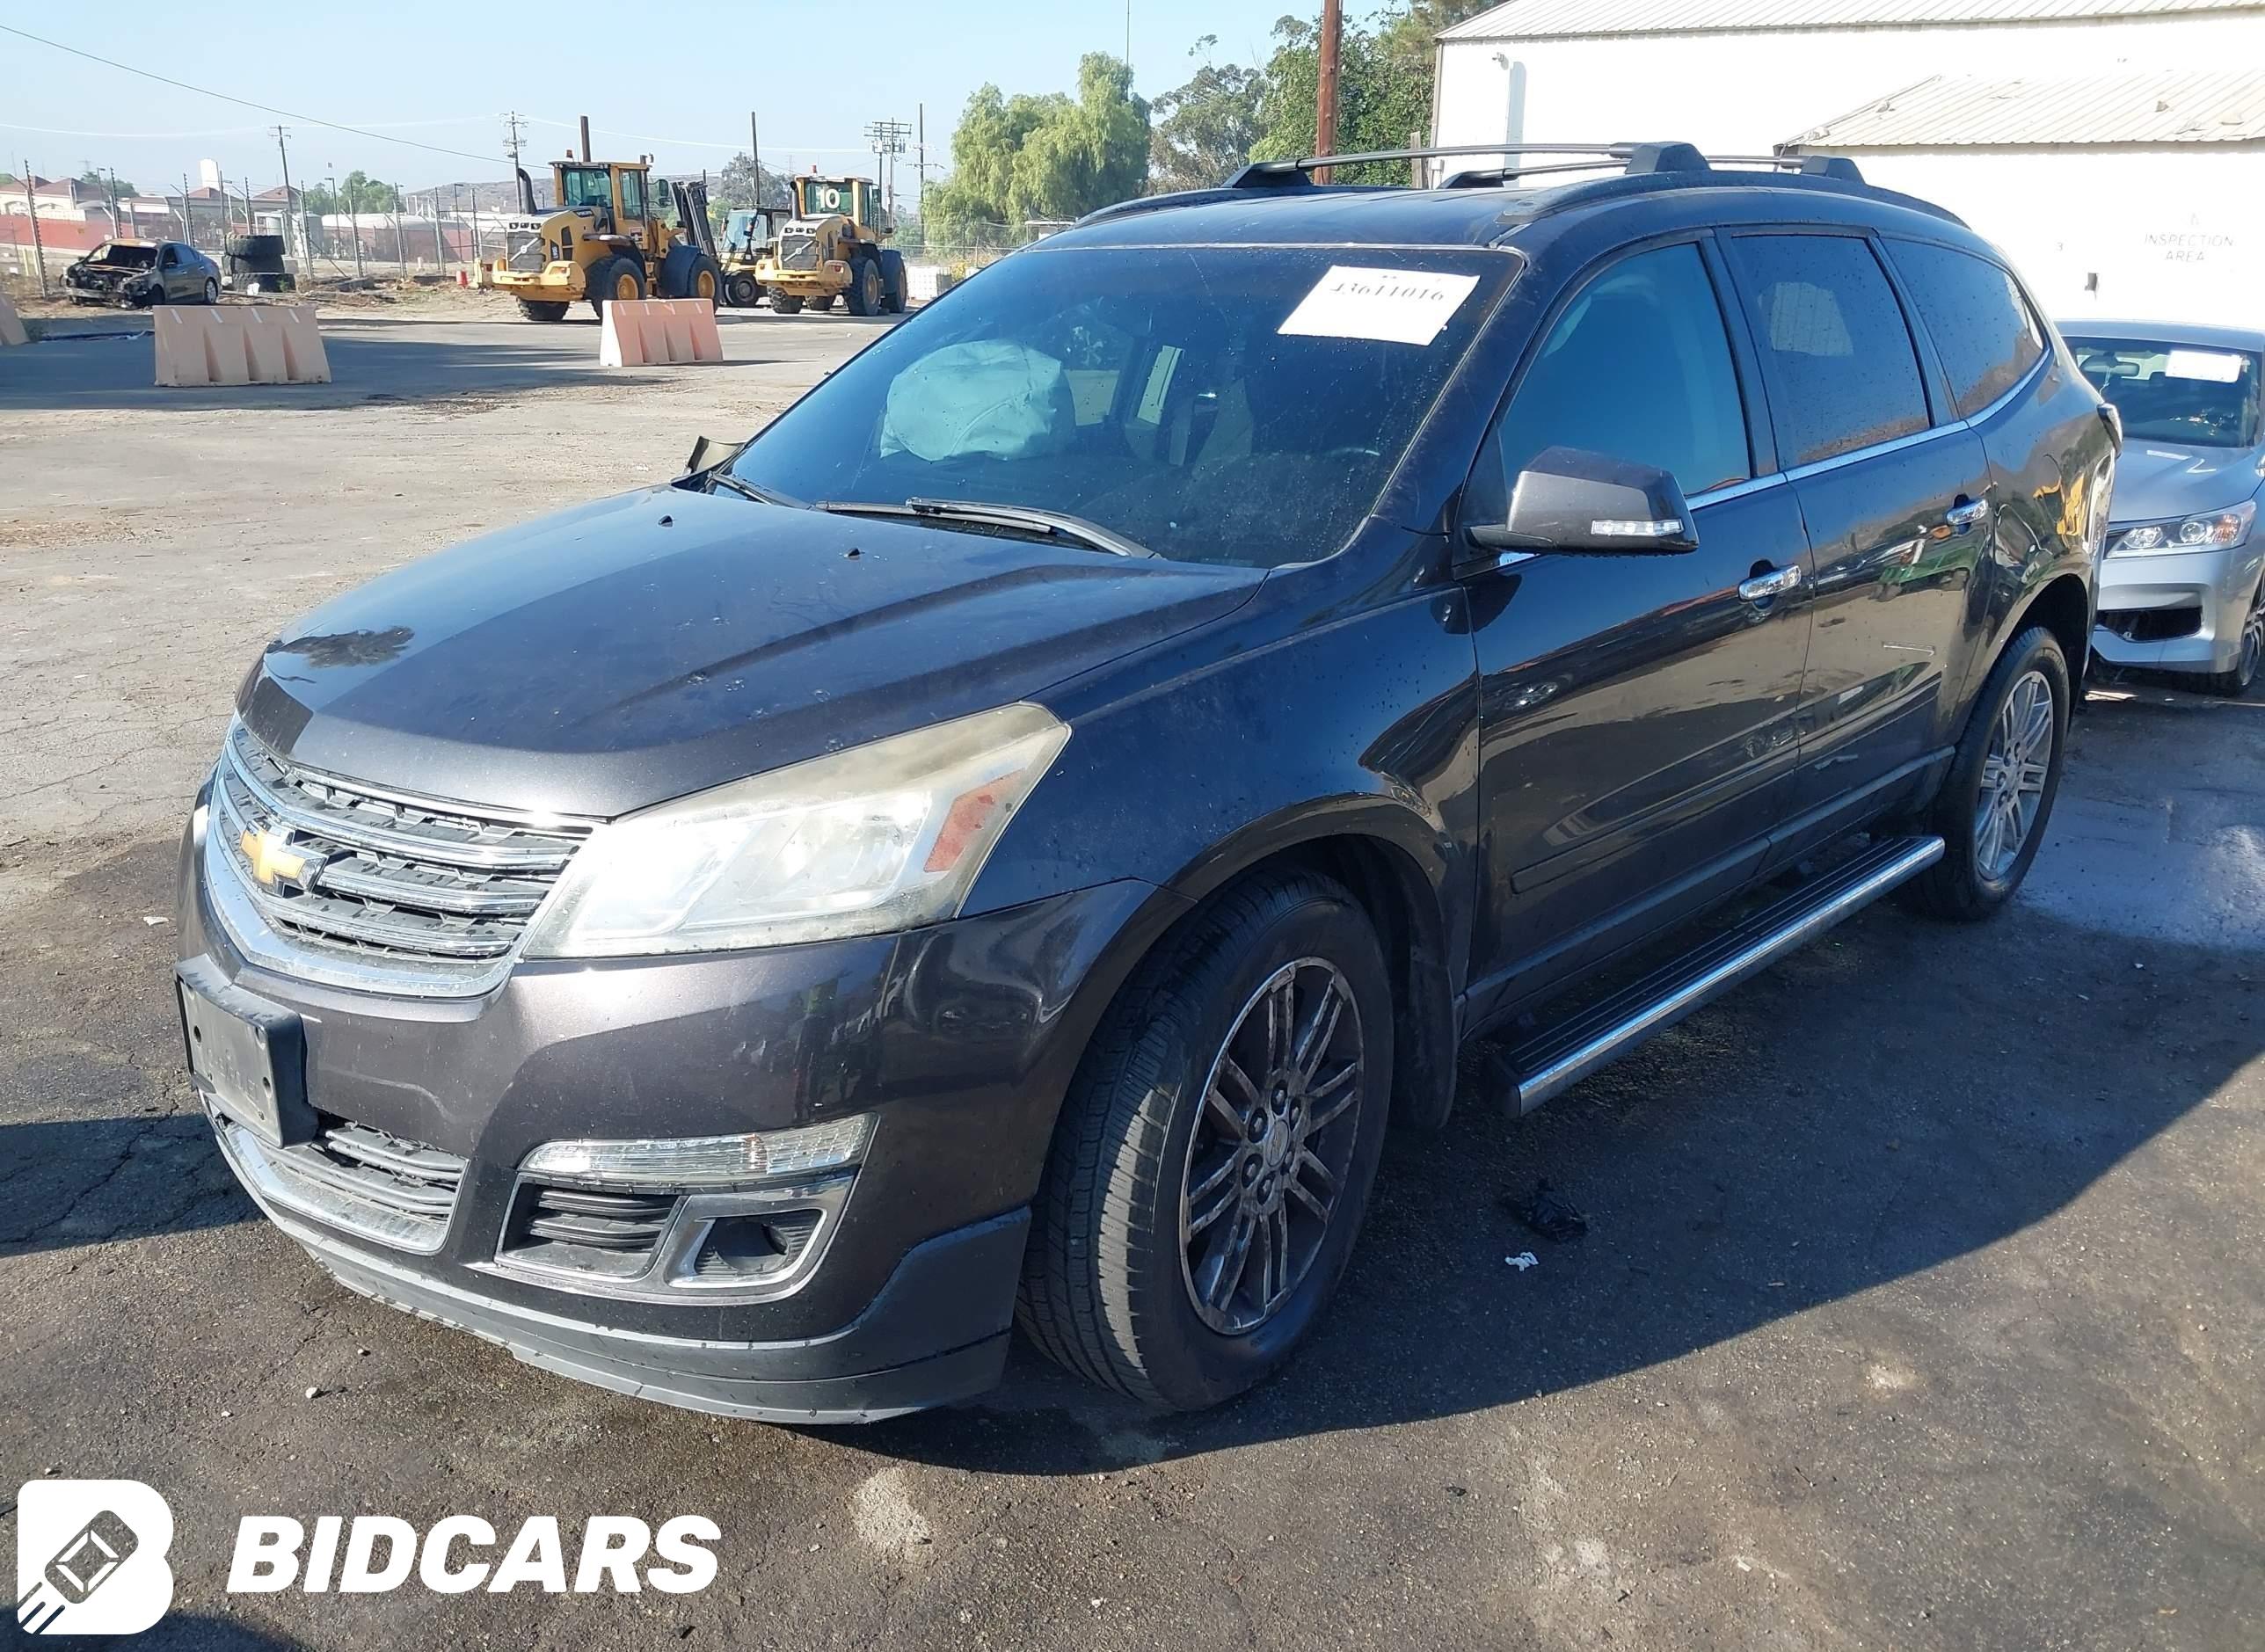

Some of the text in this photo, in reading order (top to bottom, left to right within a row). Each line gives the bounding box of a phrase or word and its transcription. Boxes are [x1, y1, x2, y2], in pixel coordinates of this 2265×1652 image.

[819, 186, 841, 209] 10
[2144, 233, 2234, 247] INSPECTION
[2166, 250, 2205, 262] AREA
